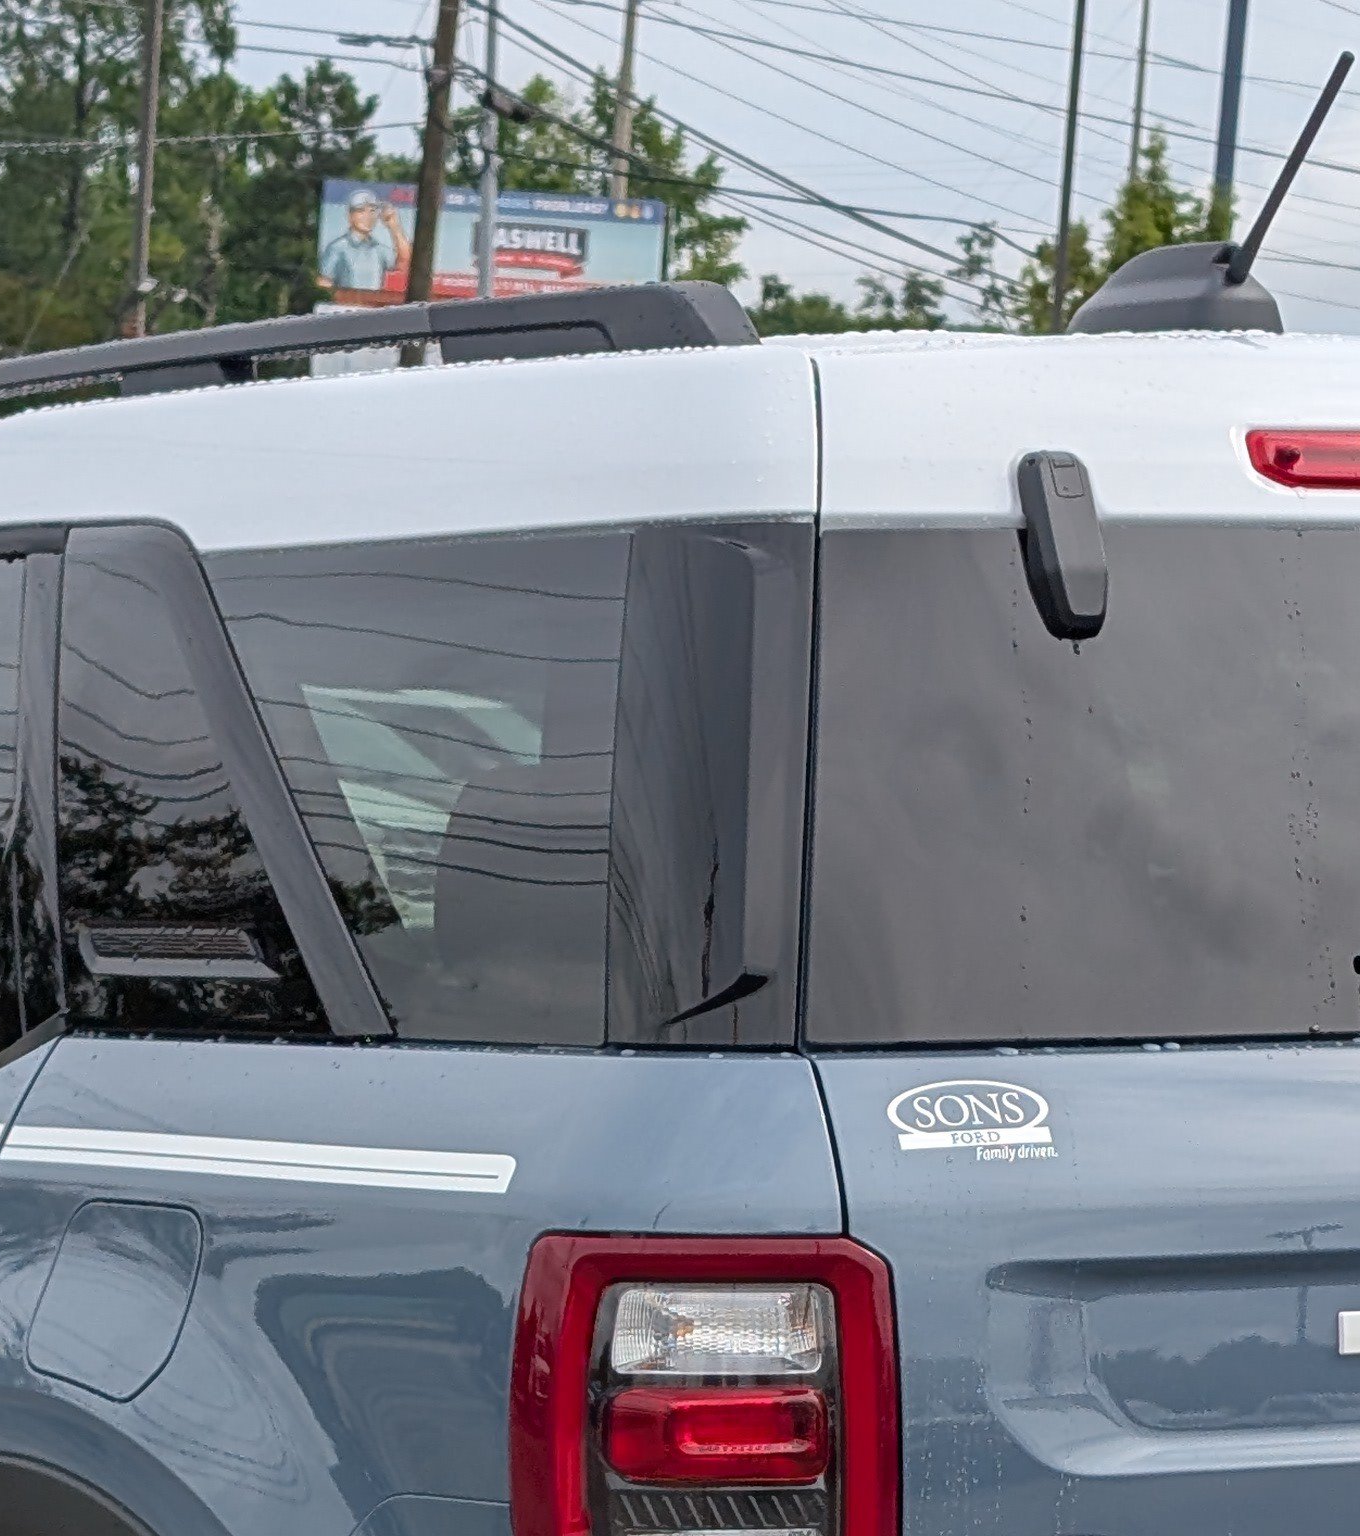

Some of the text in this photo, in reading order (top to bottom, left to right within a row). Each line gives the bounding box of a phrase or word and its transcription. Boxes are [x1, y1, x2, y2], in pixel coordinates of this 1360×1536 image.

[493, 229, 582, 255] ASWELL
[913, 1092, 1024, 1128] SONS
[951, 1131, 1001, 1144] FORD
[976, 1144, 1015, 1162] Family
